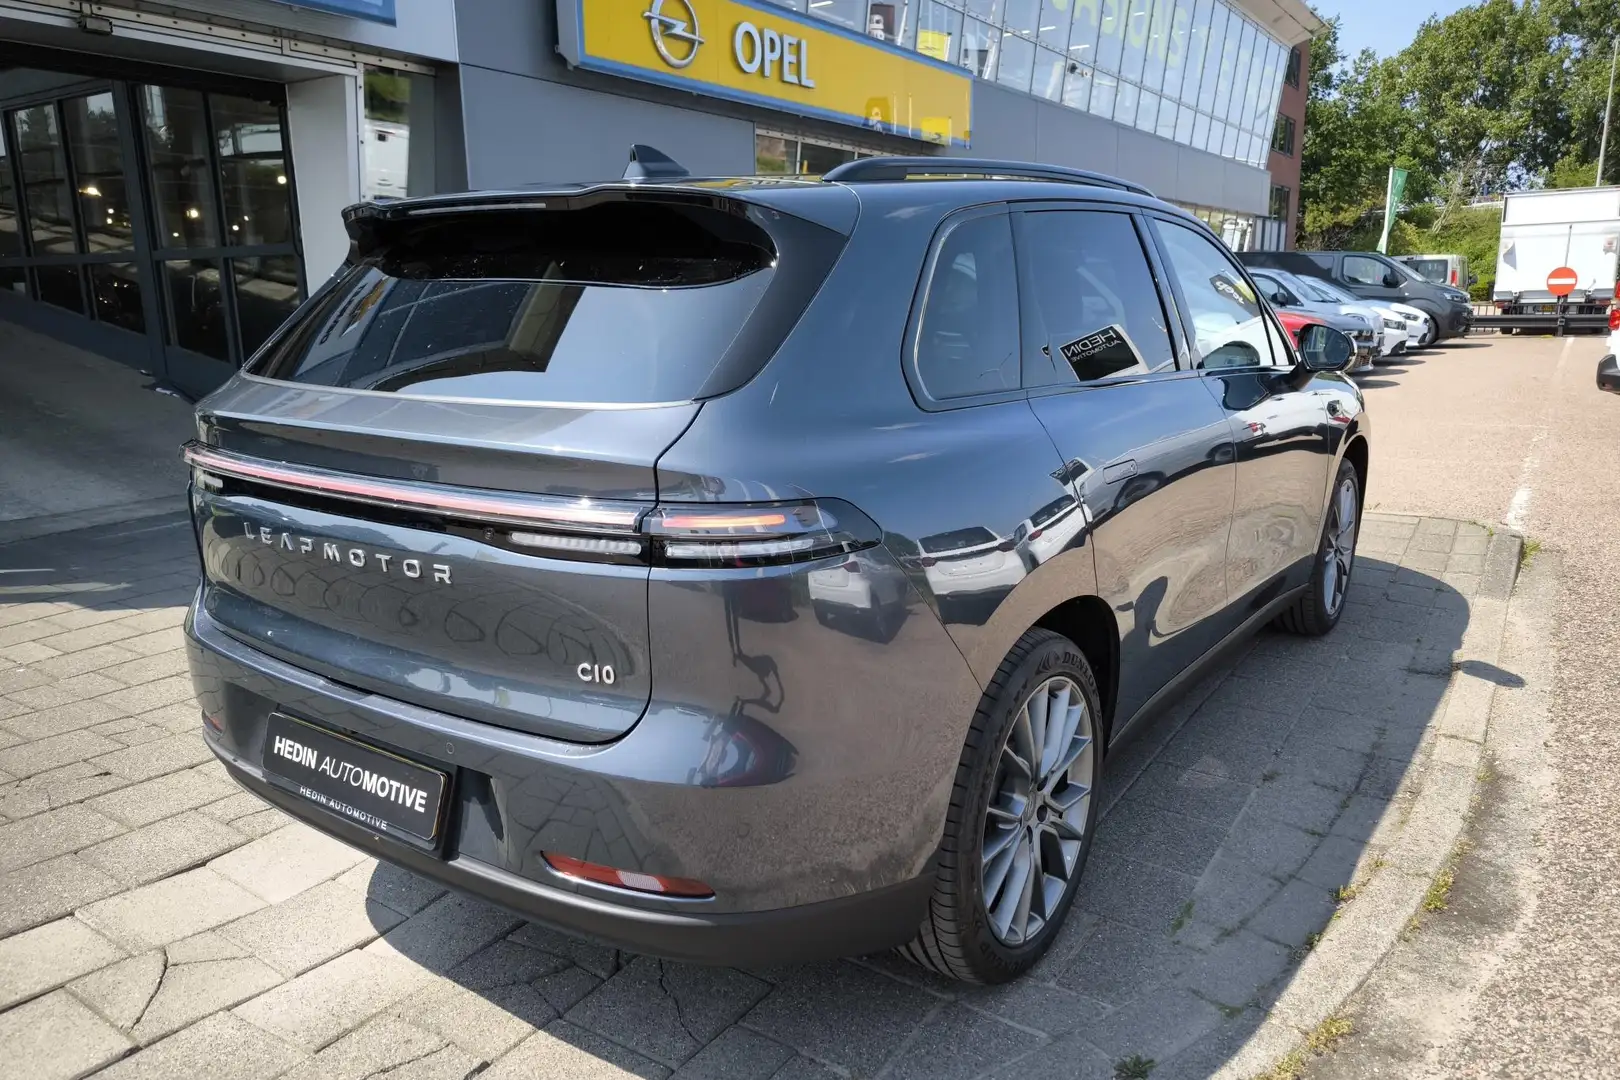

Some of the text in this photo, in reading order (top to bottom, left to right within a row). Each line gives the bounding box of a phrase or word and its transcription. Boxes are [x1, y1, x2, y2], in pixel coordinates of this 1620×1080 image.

[733, 20, 815, 89] OPEL
[243, 521, 454, 585] LEAPMOTOR
[577, 662, 616, 686] C10
[273, 735, 428, 813] HEDIN AUTOMOTIVE
[299, 785, 388, 831] HEDIN AUTOMOTIVE
